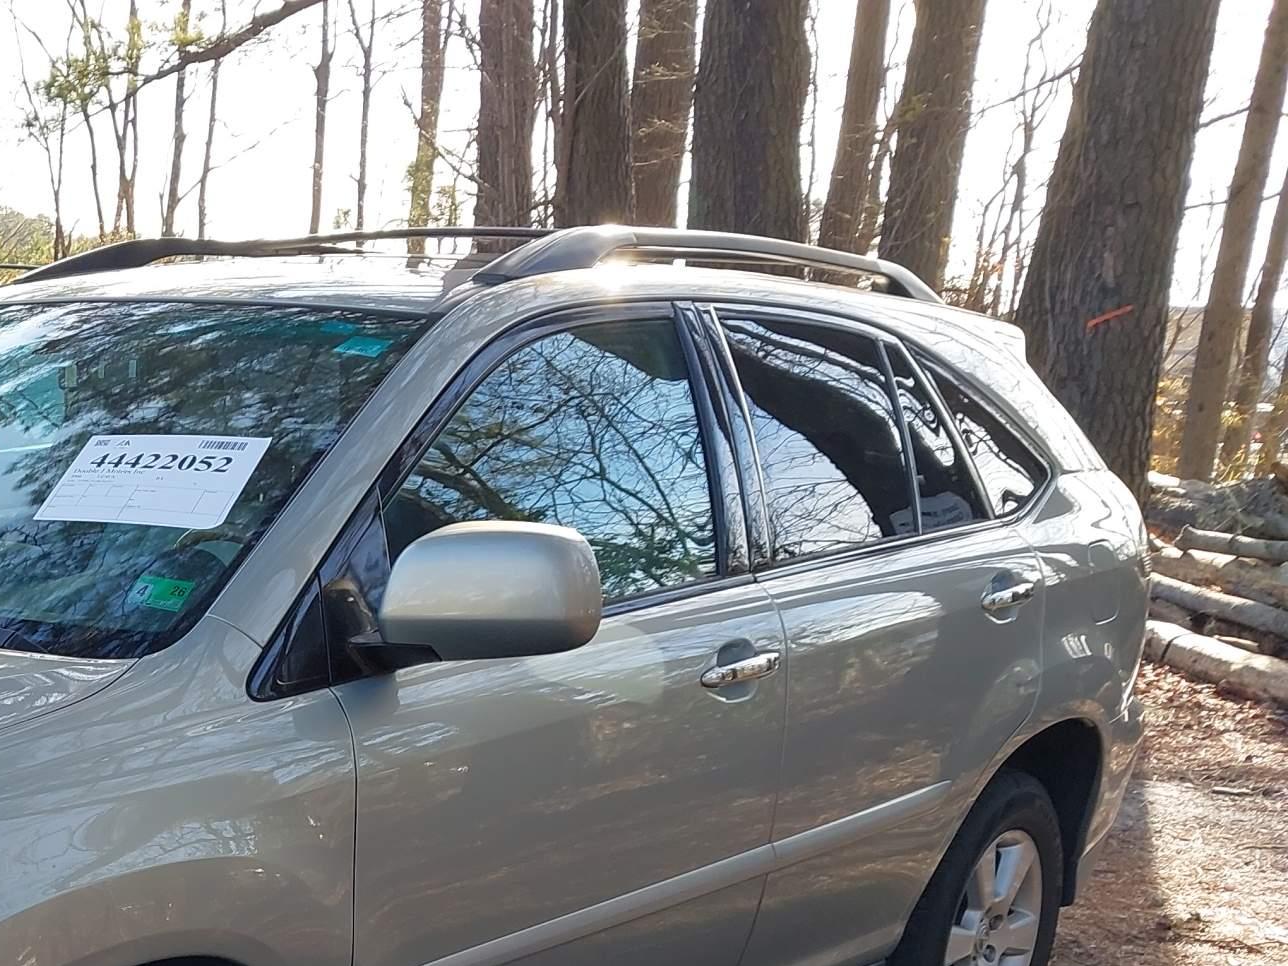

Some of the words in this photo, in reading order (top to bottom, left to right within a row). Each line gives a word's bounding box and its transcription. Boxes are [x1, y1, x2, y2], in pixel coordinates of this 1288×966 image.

[90, 452, 234, 473] 44422052
[136, 584, 149, 597] 4
[170, 585, 187, 597] 26
